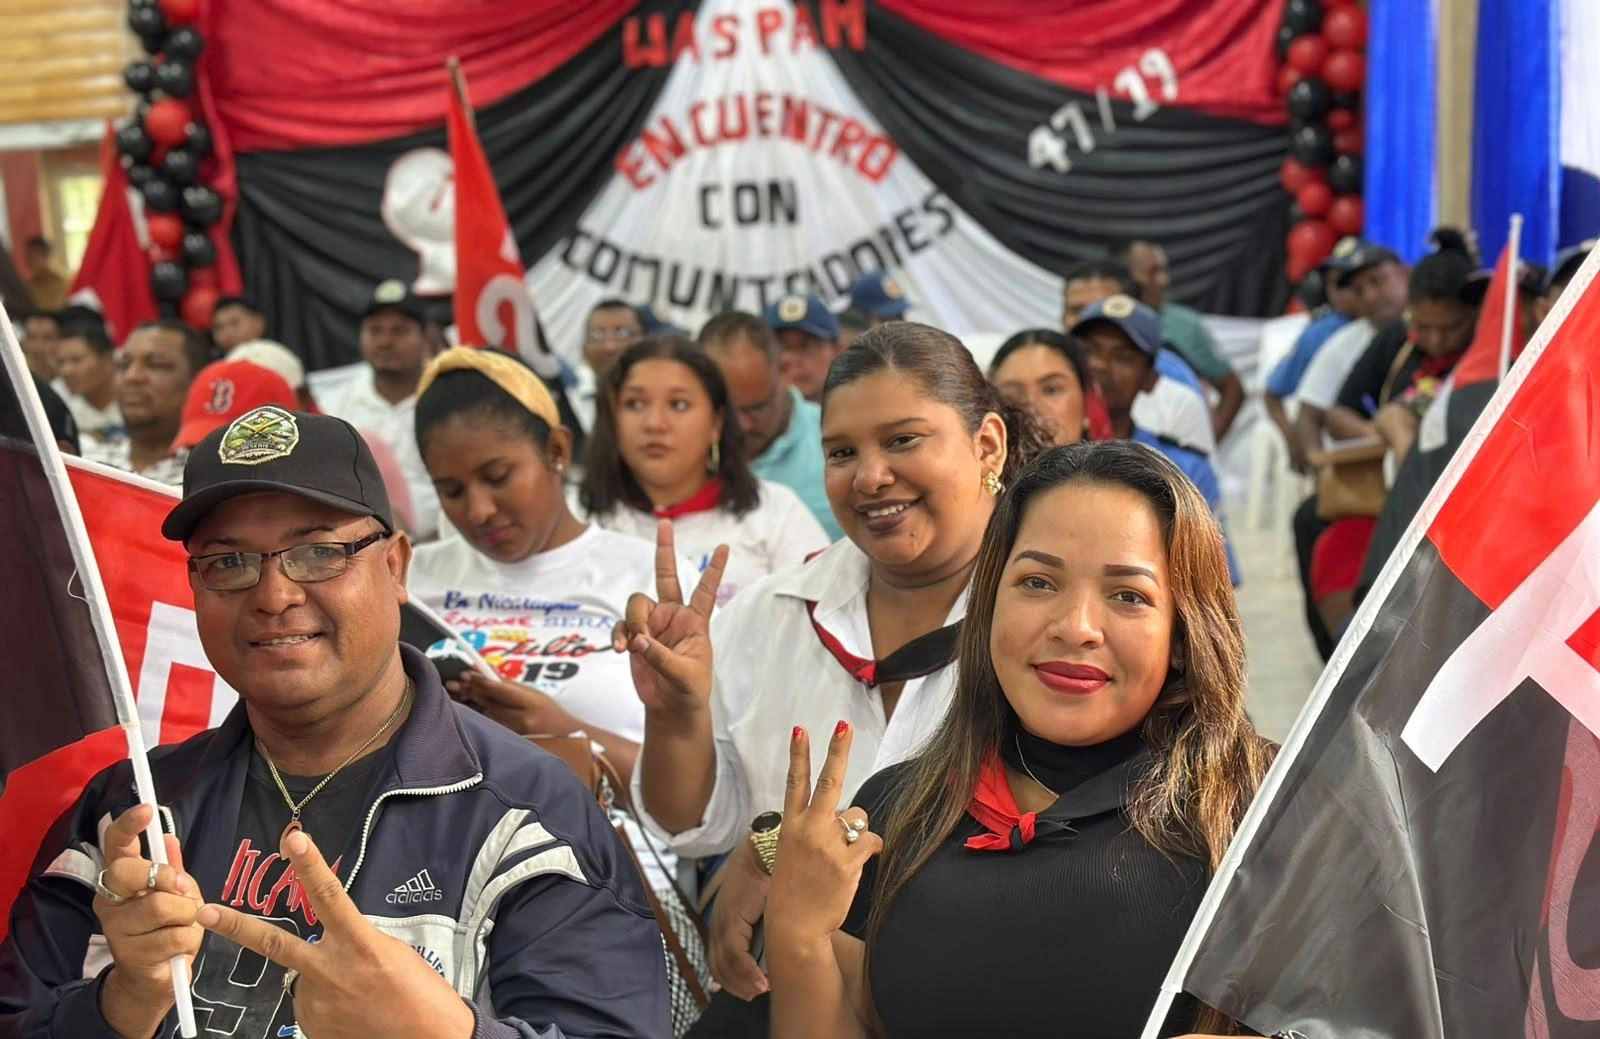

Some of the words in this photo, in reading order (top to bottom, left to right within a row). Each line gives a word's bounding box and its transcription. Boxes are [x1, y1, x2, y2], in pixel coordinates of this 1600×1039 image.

[613, 91, 899, 190] ENCUENTRO
[699, 179, 798, 228] CON
[386, 889, 443, 904] adidas
